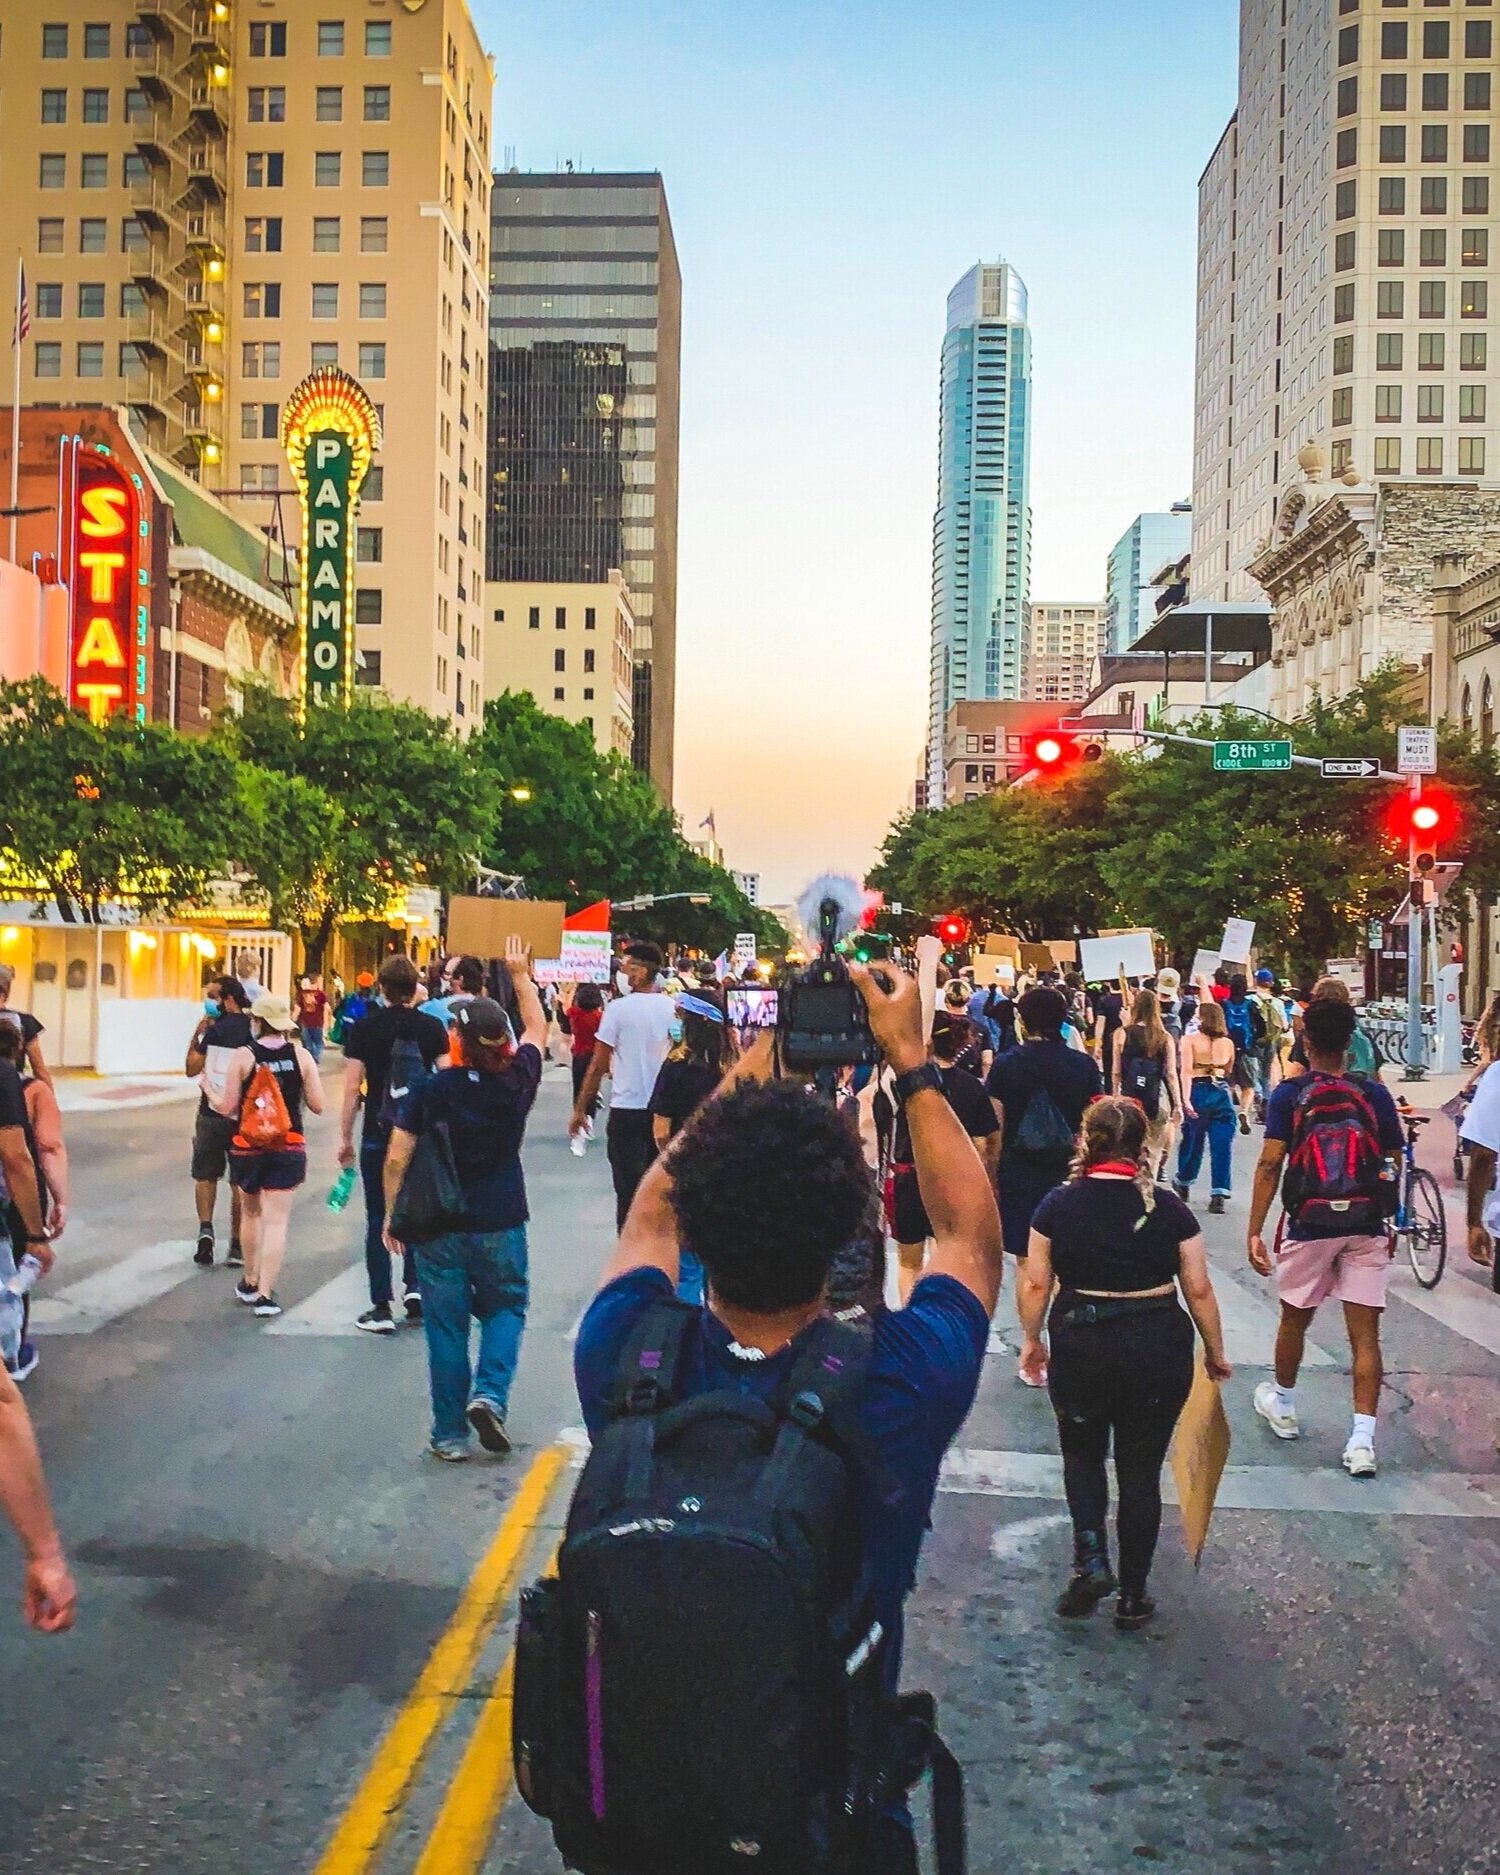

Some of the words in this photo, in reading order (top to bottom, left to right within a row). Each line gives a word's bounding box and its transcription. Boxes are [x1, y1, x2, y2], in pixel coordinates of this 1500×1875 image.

[1229, 744, 1257, 758] 8th
[1263, 743, 1276, 752] ST
[1406, 745, 1428, 754] MUST
[1222, 759, 1242, 767] 100E
[1262, 759, 1282, 767] 100W
